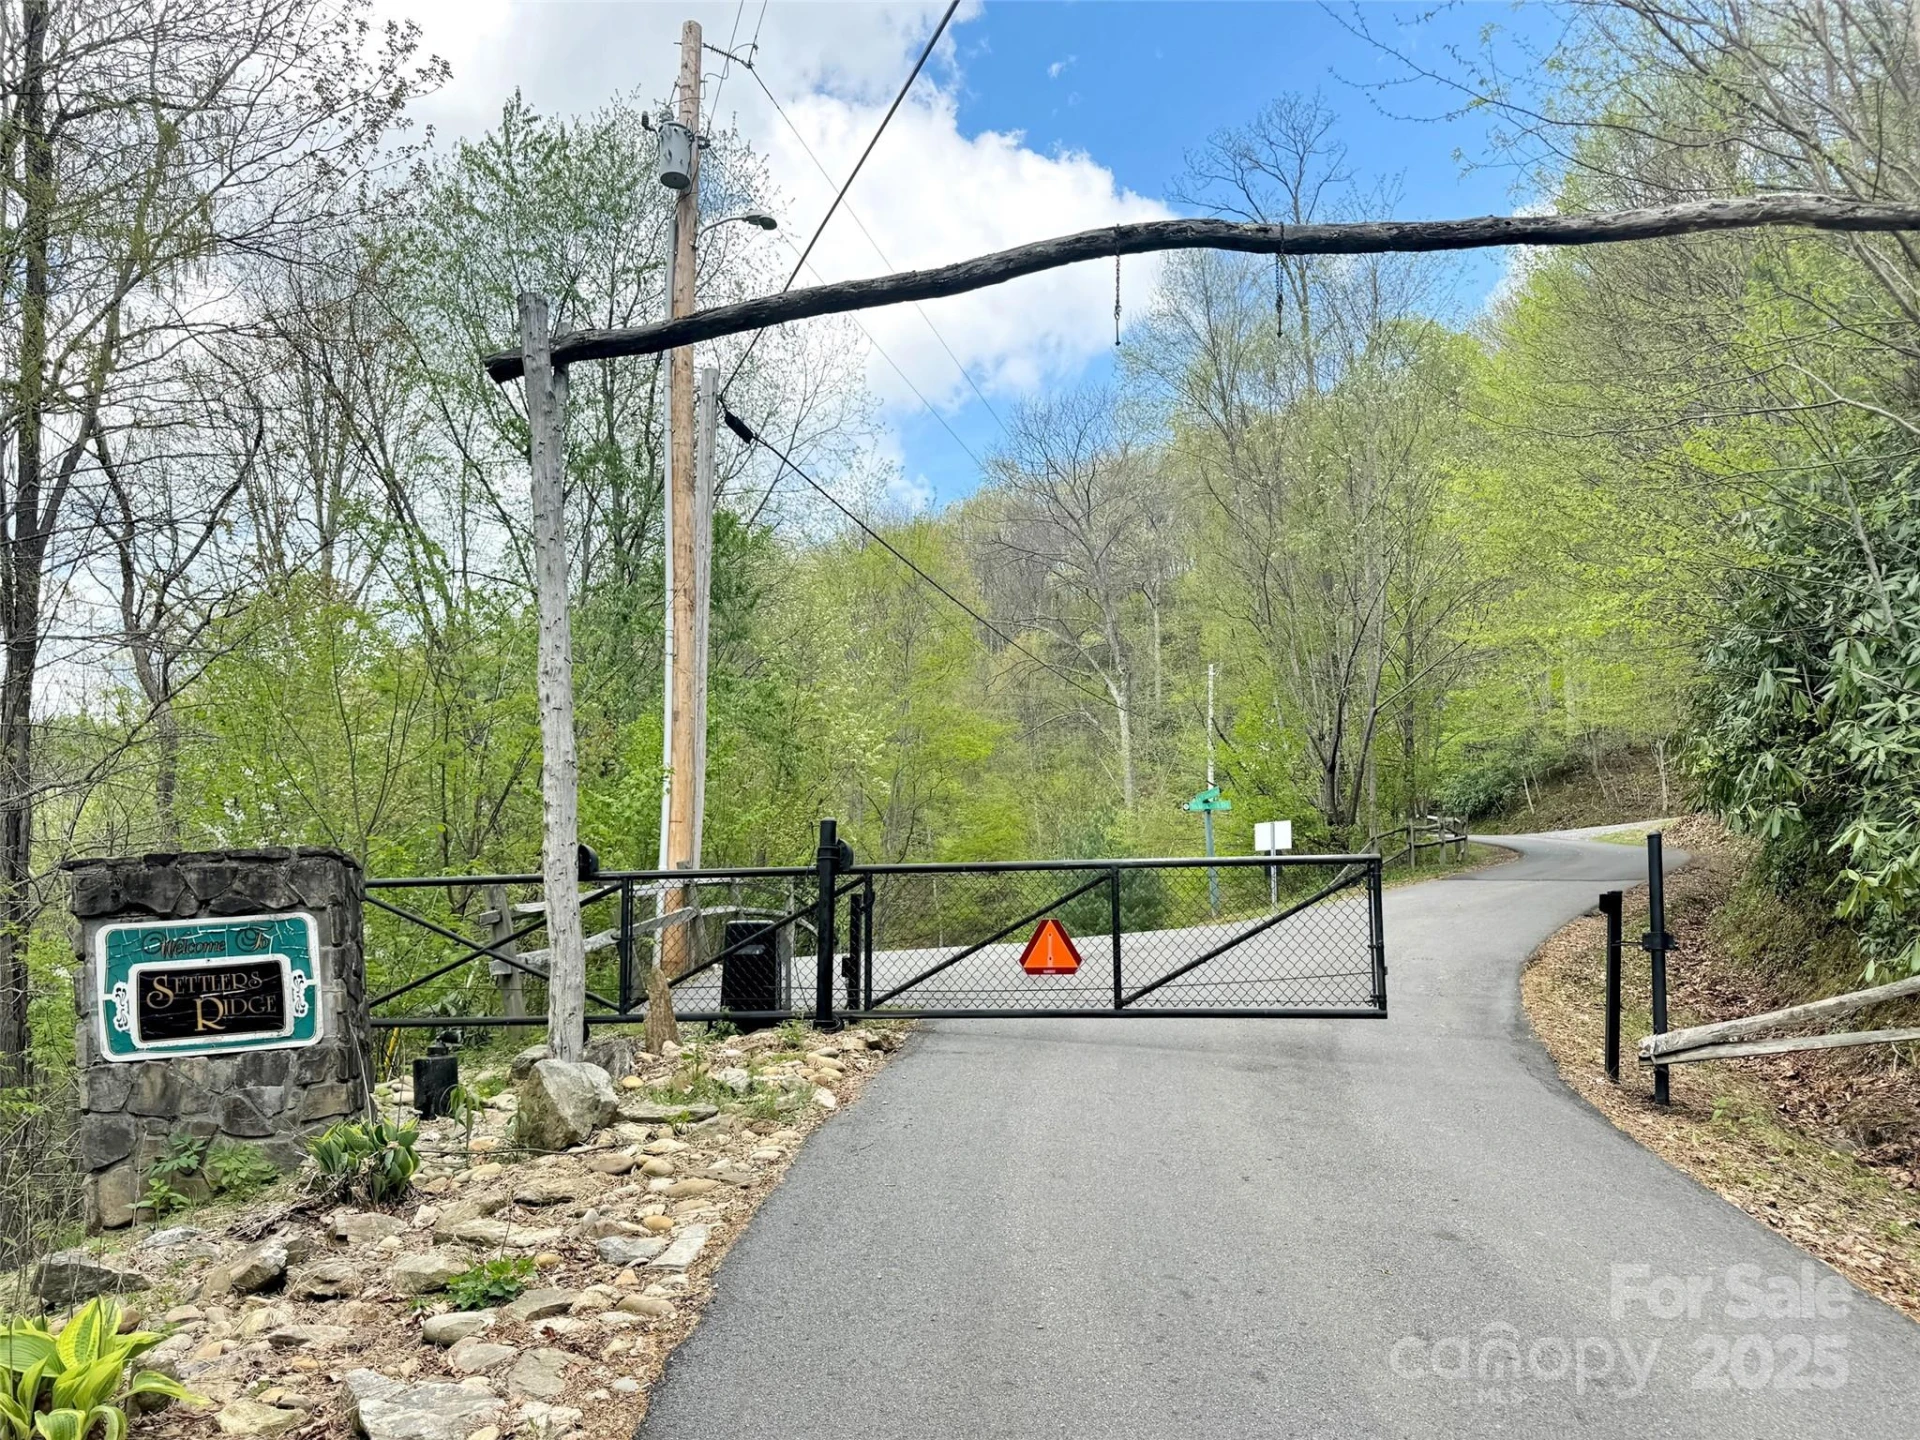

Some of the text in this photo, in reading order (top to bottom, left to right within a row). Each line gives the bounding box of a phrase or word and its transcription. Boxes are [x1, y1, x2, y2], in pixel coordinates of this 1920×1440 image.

[143, 925, 274, 957] Welcome To
[146, 971, 263, 1009] SETTLERS
[194, 995, 277, 1032] RIDGE
